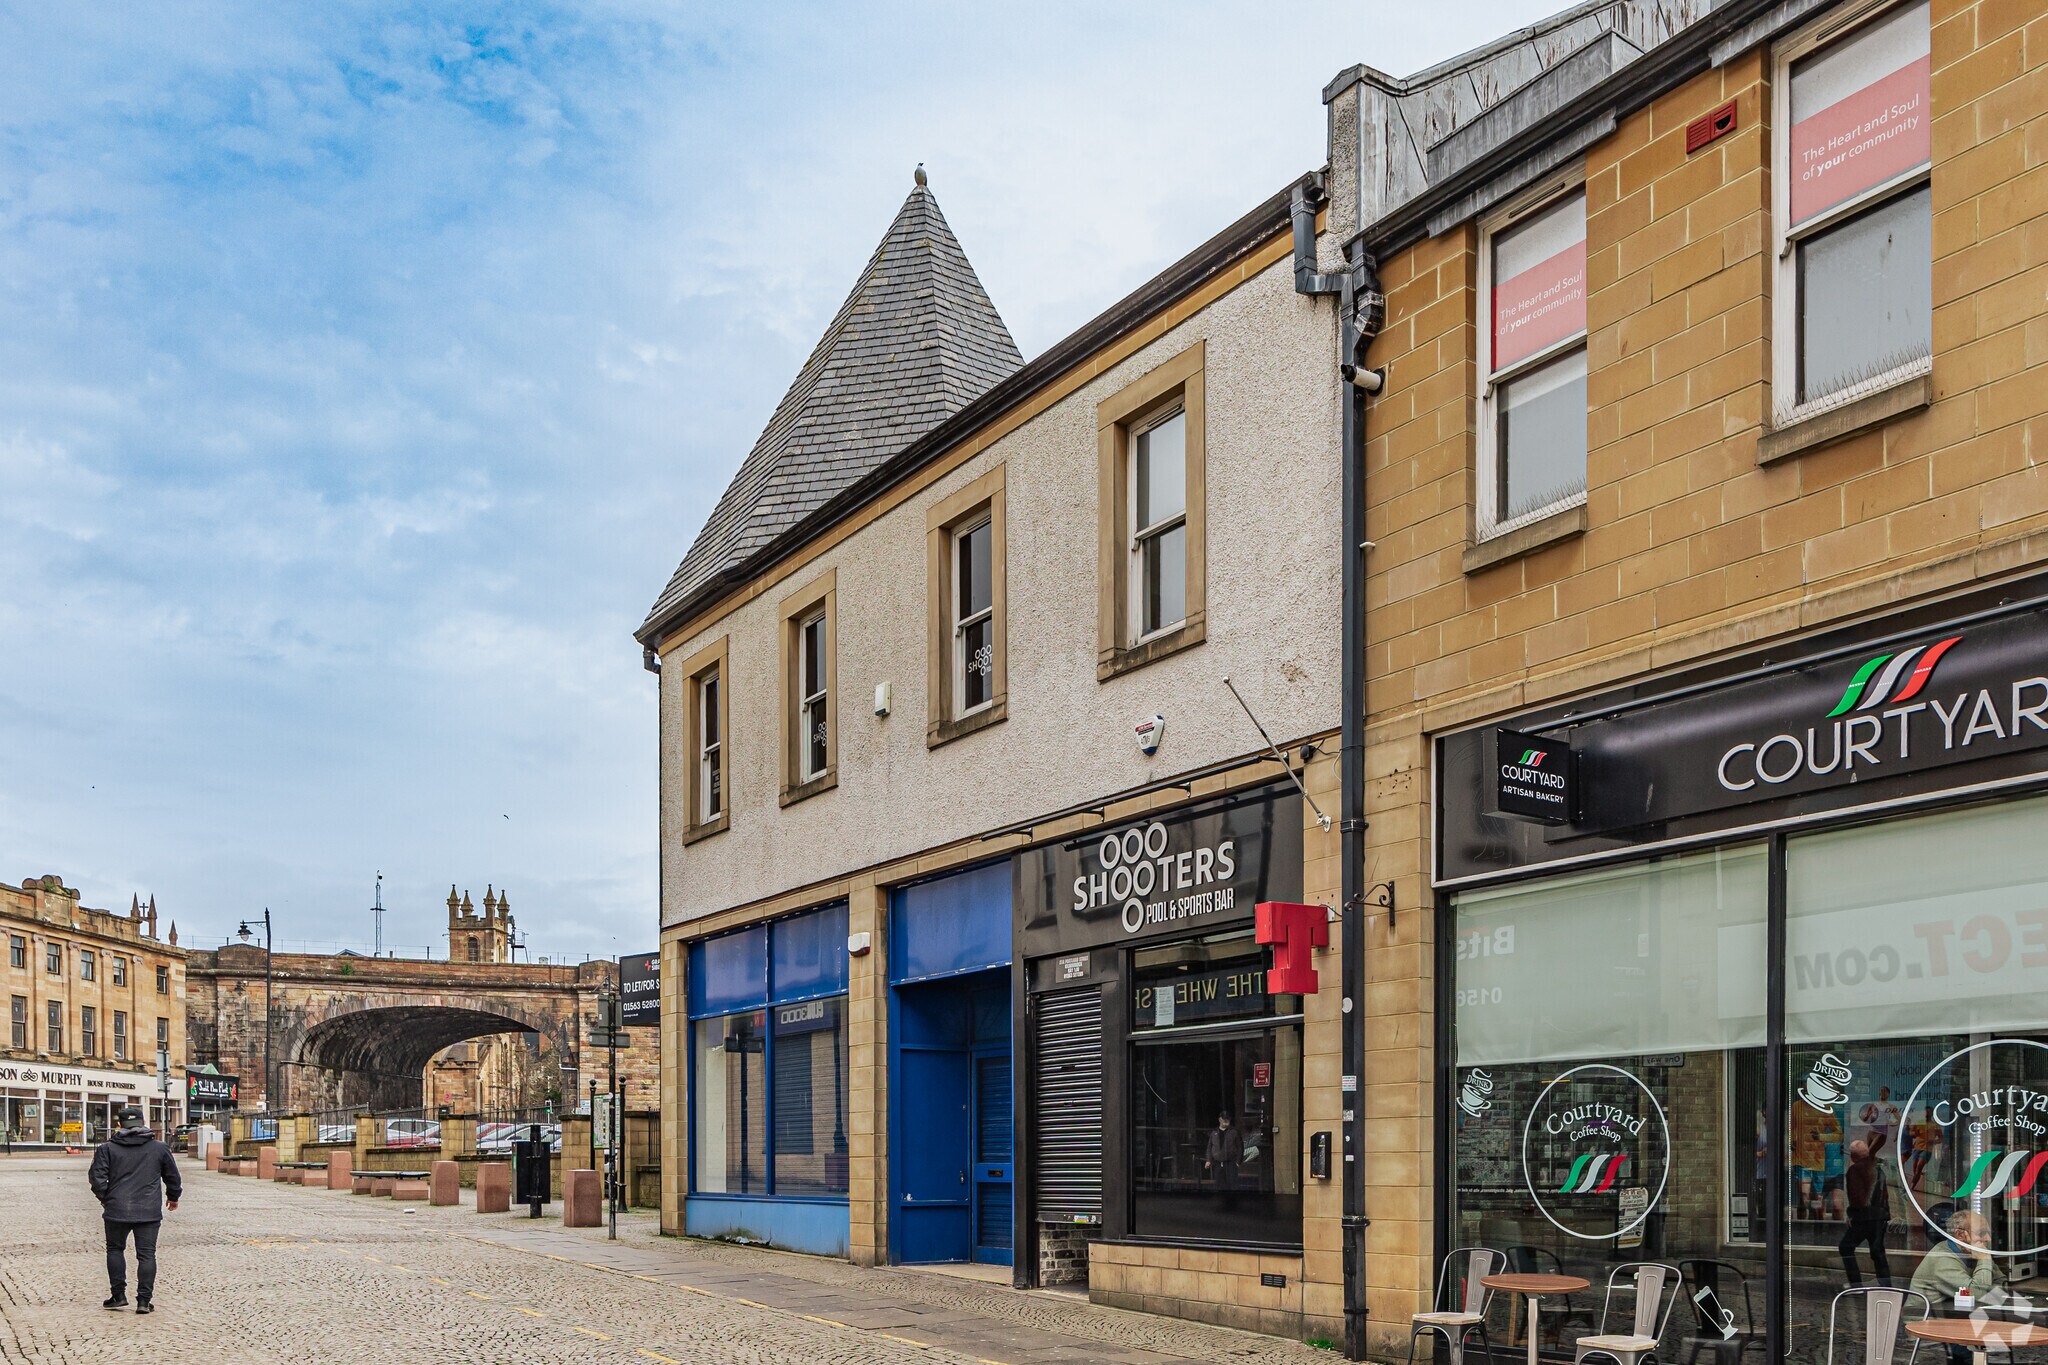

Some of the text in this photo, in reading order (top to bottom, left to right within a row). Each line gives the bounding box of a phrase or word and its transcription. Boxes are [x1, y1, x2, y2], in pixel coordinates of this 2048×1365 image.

[1803, 93, 1919, 163] The Heart and Soul
[1802, 115, 1919, 181] of your community
[1500, 269, 1582, 320] The Heart and Soul
[1500, 288, 1582, 335] of your community
[1717, 677, 2048, 791] COURTYAR
[1501, 764, 1565, 789] COURTYARD
[1502, 785, 1564, 803] ARTISAN BAKERY
[1073, 841, 1236, 911] SHOOTERS
[1146, 900, 1168, 924] POOL
[1169, 900, 1176, 920] &
[1178, 893, 1213, 919] SPORTS
[1214, 887, 1234, 912] BAR
[623, 982, 632, 994] TO
[632, 979, 655, 993] LET/FOR
[41, 1071, 82, 1086] MURPHY
[87, 1080, 104, 1088] HOUSE
[105, 1080, 136, 1090] FURNISHERS
[1465, 1076, 1490, 1090] DRINK
[1813, 1061, 1846, 1080] DRINK
[1546, 1101, 1647, 1137] Courtyard
[1569, 1124, 1622, 1143] Coffee Shop
[1968, 1114, 2047, 1137] Coffee Shop
